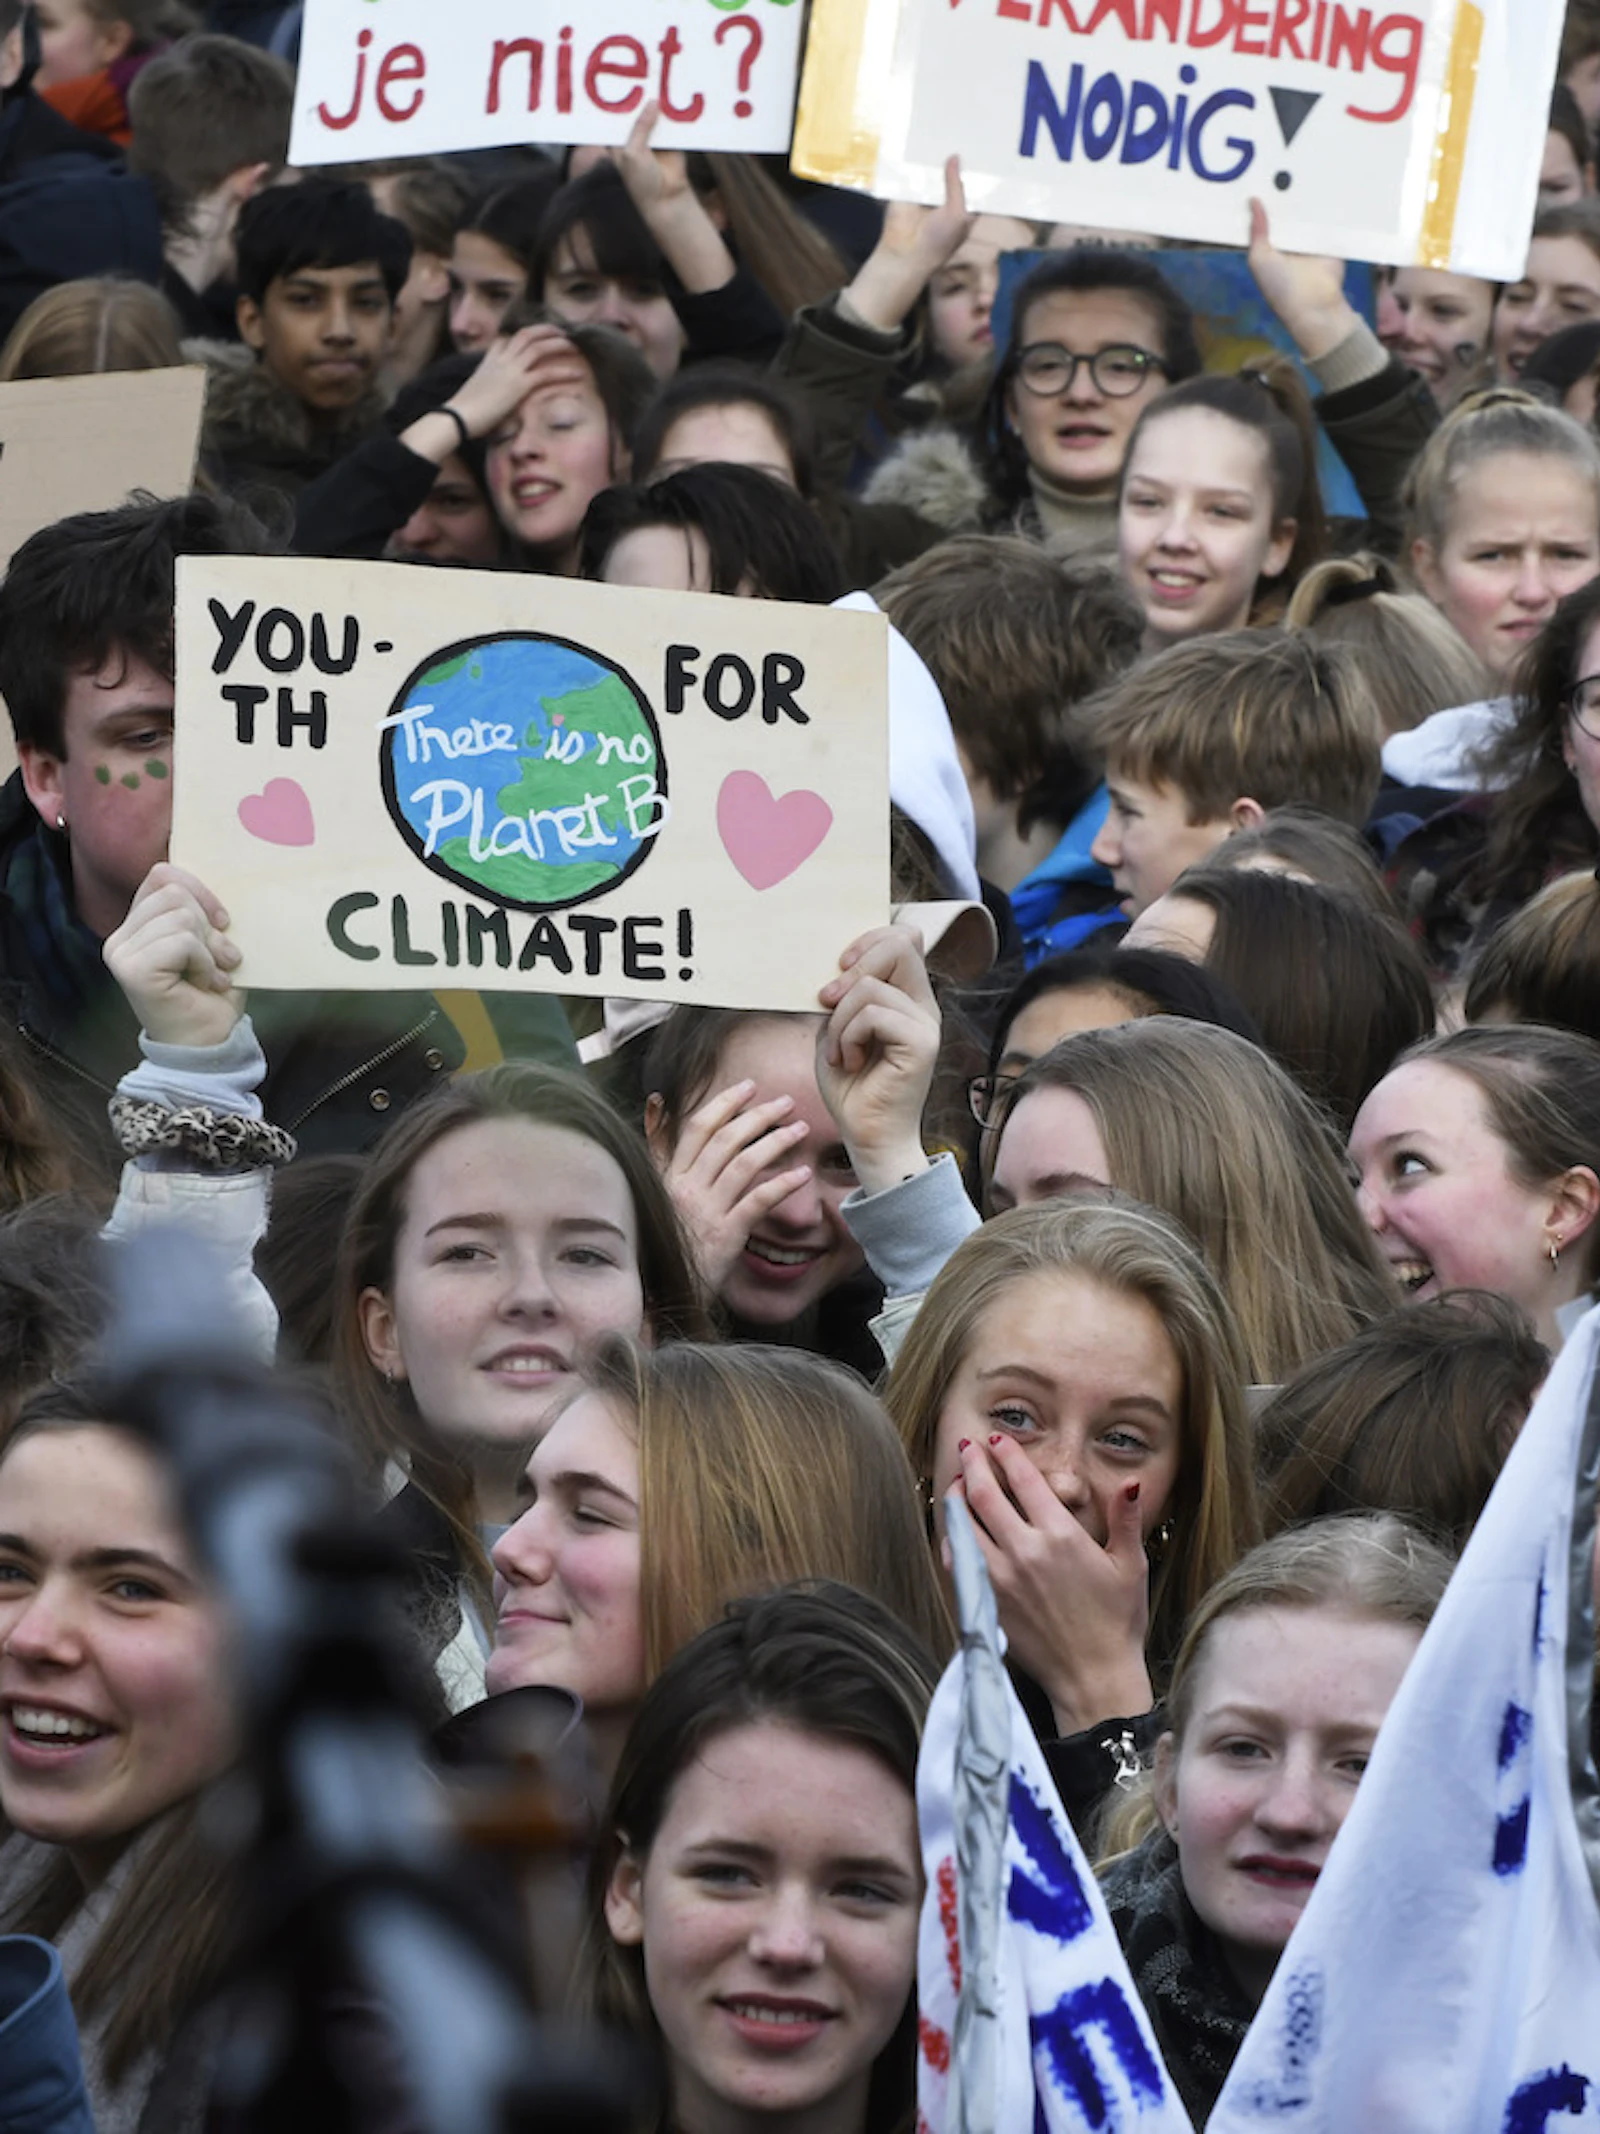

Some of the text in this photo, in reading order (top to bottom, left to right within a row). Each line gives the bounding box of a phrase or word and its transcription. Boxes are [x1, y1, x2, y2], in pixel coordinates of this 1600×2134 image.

[318, 14, 764, 130] je niet?
[208, 597, 394, 675] YOU-
[220, 684, 328, 749] TH
[665, 644, 810, 725] FOR
[375, 704, 652, 765] There is no
[410, 773, 673, 863] Planet B
[326, 891, 694, 981] CLIMATE!
